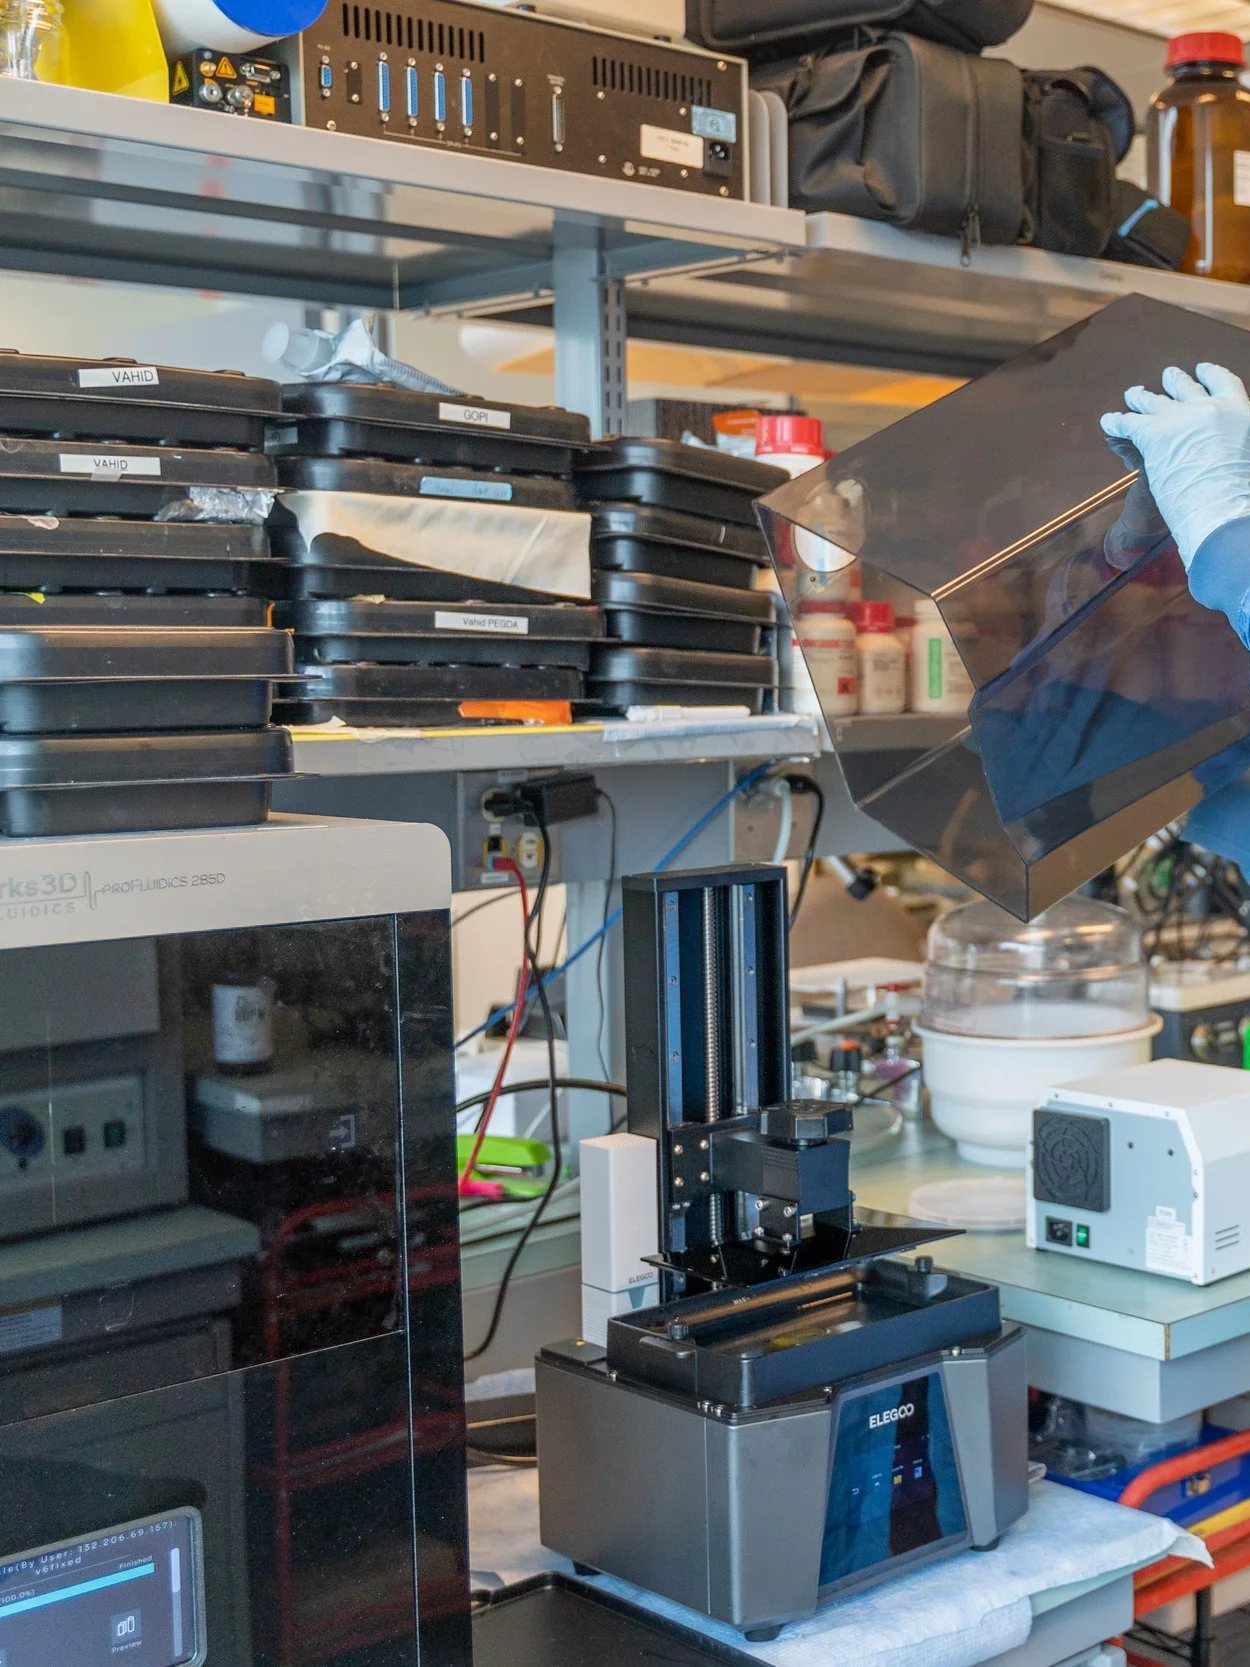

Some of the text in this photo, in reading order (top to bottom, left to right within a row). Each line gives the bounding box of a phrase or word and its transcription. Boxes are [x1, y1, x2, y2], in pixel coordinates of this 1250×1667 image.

[112, 370, 154, 383] VAHID
[463, 409, 488, 422] GOPI
[94, 459, 128, 470] VAHID
[463, 617, 486, 627] Vahid
[191, 873, 225, 886] 285D
[0, 902, 76, 920] UIDICS
[869, 1403, 914, 1429] ELEGOO
[40, 1549, 73, 1564] User:
[119, 1555, 153, 1570] Finished
[35, 1556, 82, 1575] v6fixed
[111, 1639, 142, 1654] Preview
